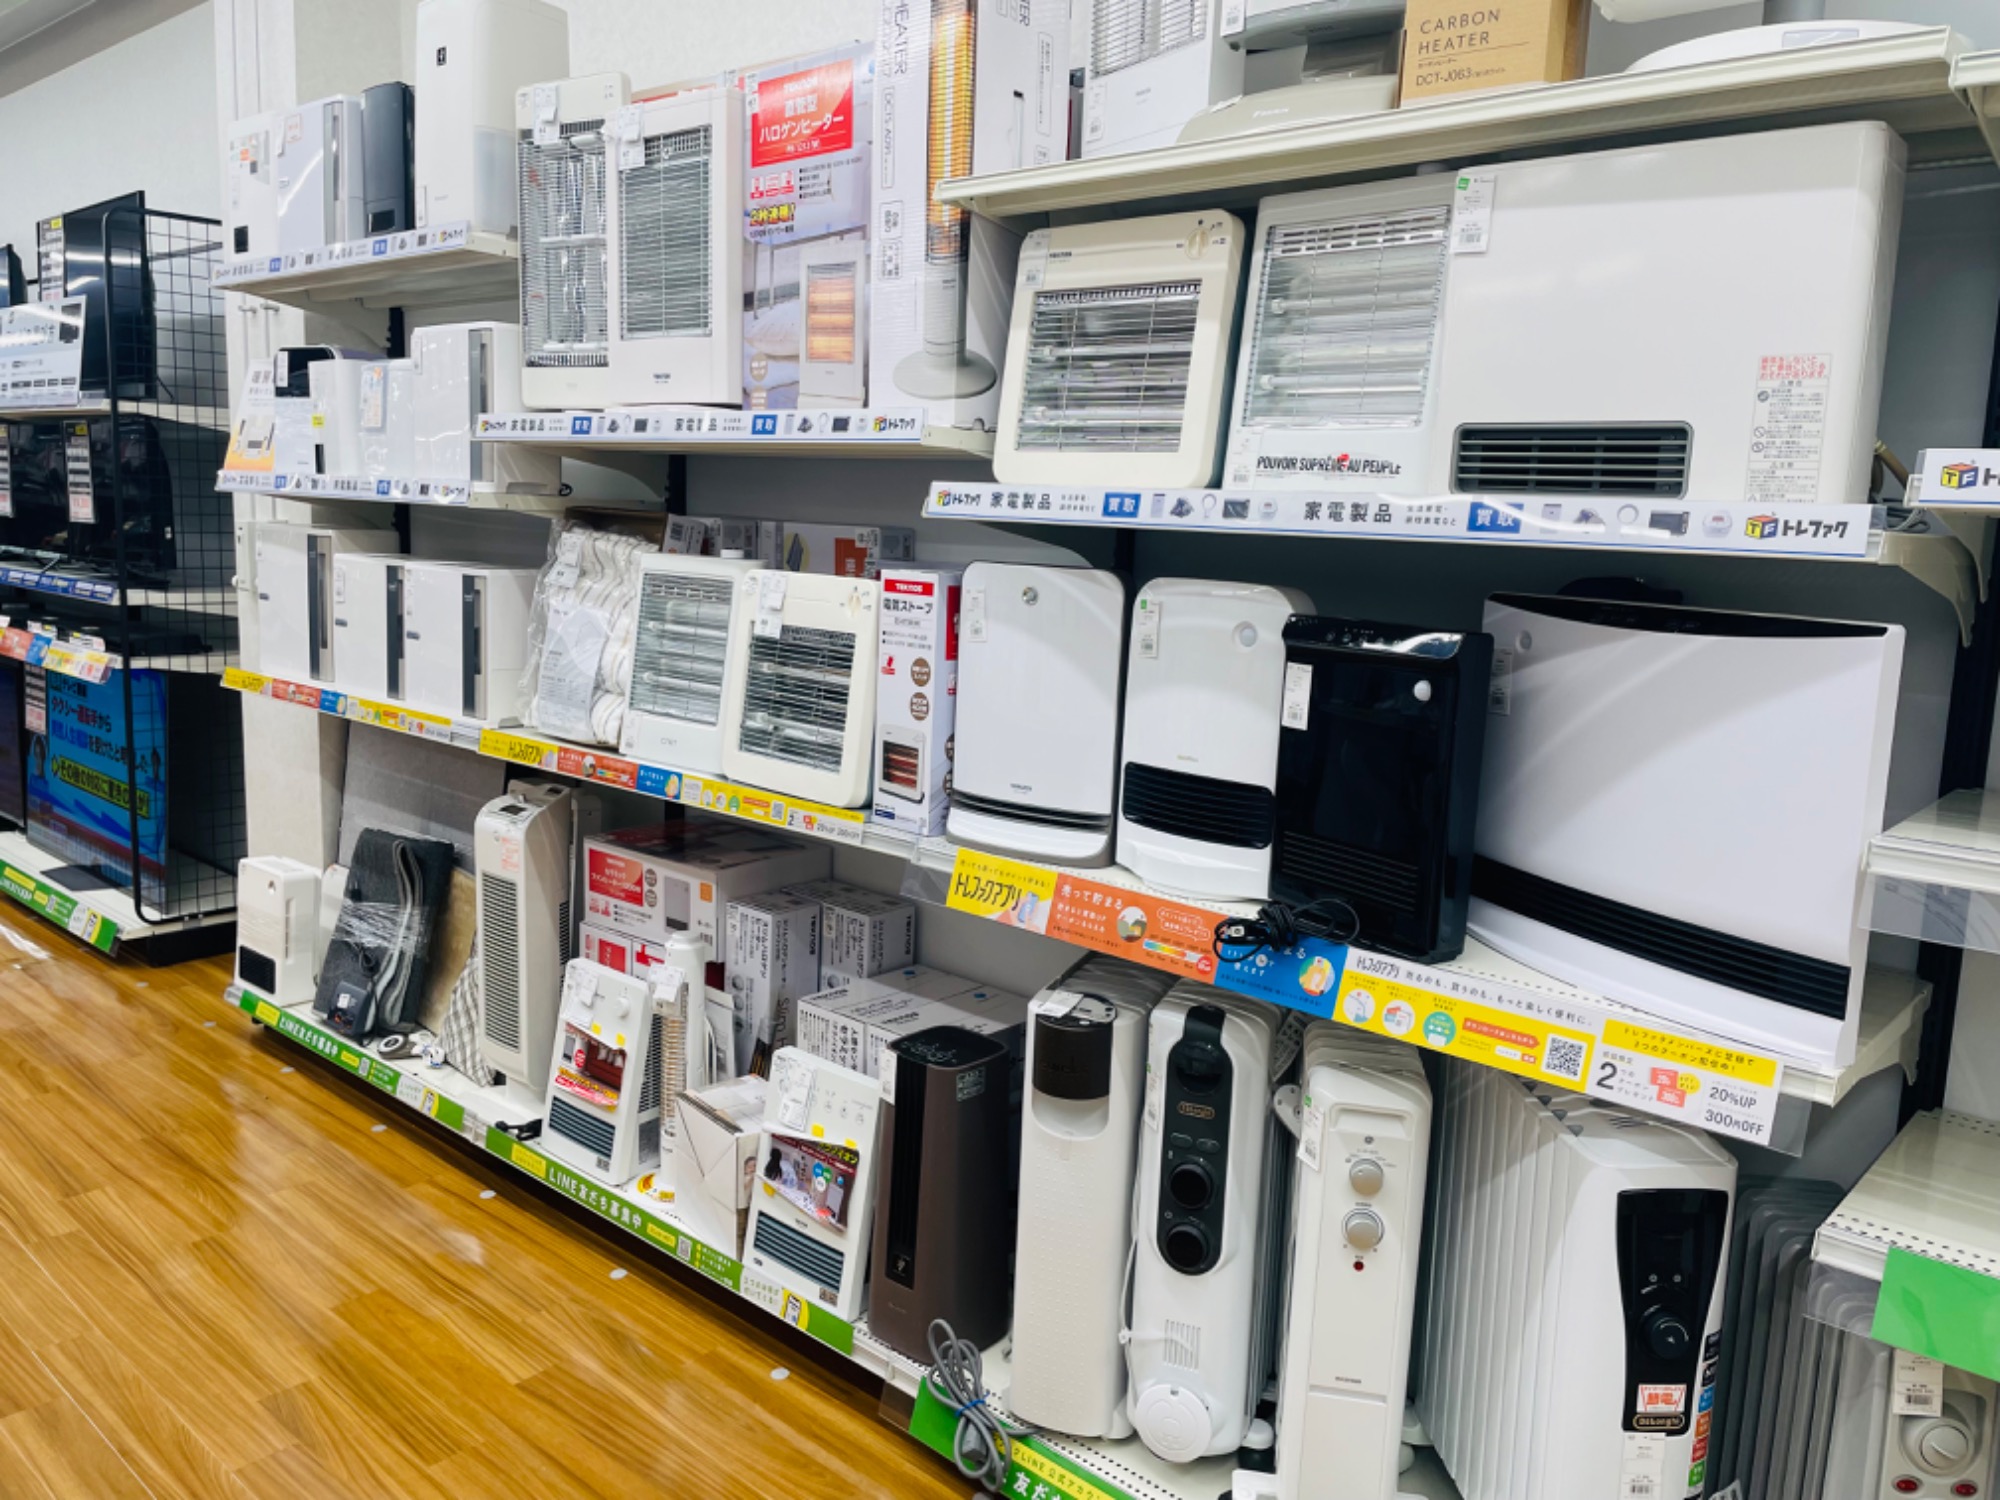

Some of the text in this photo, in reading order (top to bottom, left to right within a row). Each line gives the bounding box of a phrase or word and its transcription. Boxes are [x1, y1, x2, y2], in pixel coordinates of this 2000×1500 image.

[1420, 8, 1500, 34] CARBON
[1418, 31, 1489, 54] HEATER
[759, 114, 845, 145] ハロゲンヒーター
[990, 491, 1051, 511] 家電製品
[1107, 494, 1136, 515] 買取
[1304, 500, 1394, 524] 家電製品
[1476, 508, 1515, 527] 買取
[1781, 519, 1849, 540] トレファク
[883, 597, 933, 615] 電気ストーブ
[1060, 883, 1124, 910] 売って貯まる
[1596, 1061, 1618, 1090] 2
[1709, 1086, 1757, 1109] 20%UP
[1704, 1108, 1764, 1136] 300円OFF
[548, 1166, 642, 1230] LINE友だち募集中
[1048, 1467, 1103, 1500] 公式アカウ
